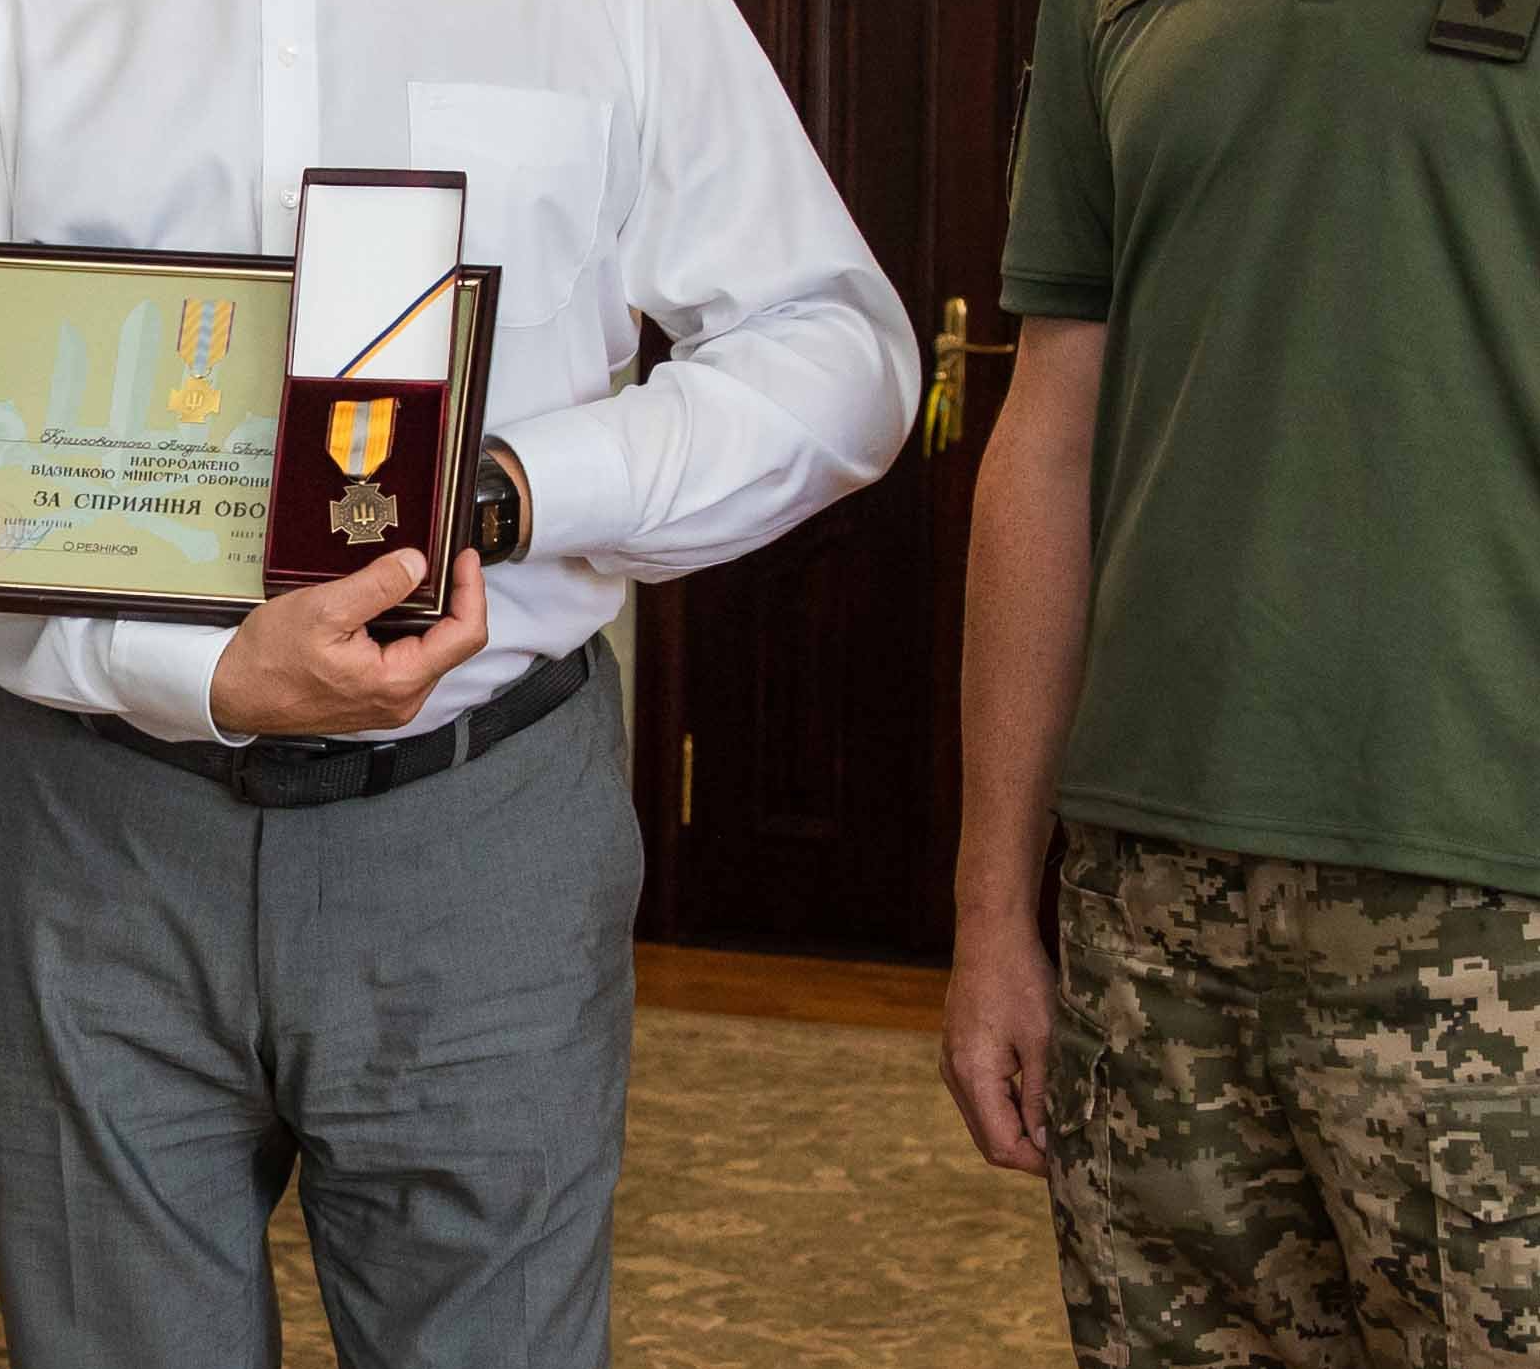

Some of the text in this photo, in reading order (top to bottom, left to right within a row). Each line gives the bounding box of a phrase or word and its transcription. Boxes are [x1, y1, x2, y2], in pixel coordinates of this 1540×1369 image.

[31, 464, 269, 488] ВІДЗНАКОЮ МІНІСТРА ОБОРОНИ
[130, 456, 239, 472] НАГОРОДЖЕНО
[33, 490, 266, 519] ЗА СПРИЯННЯ ОБО
